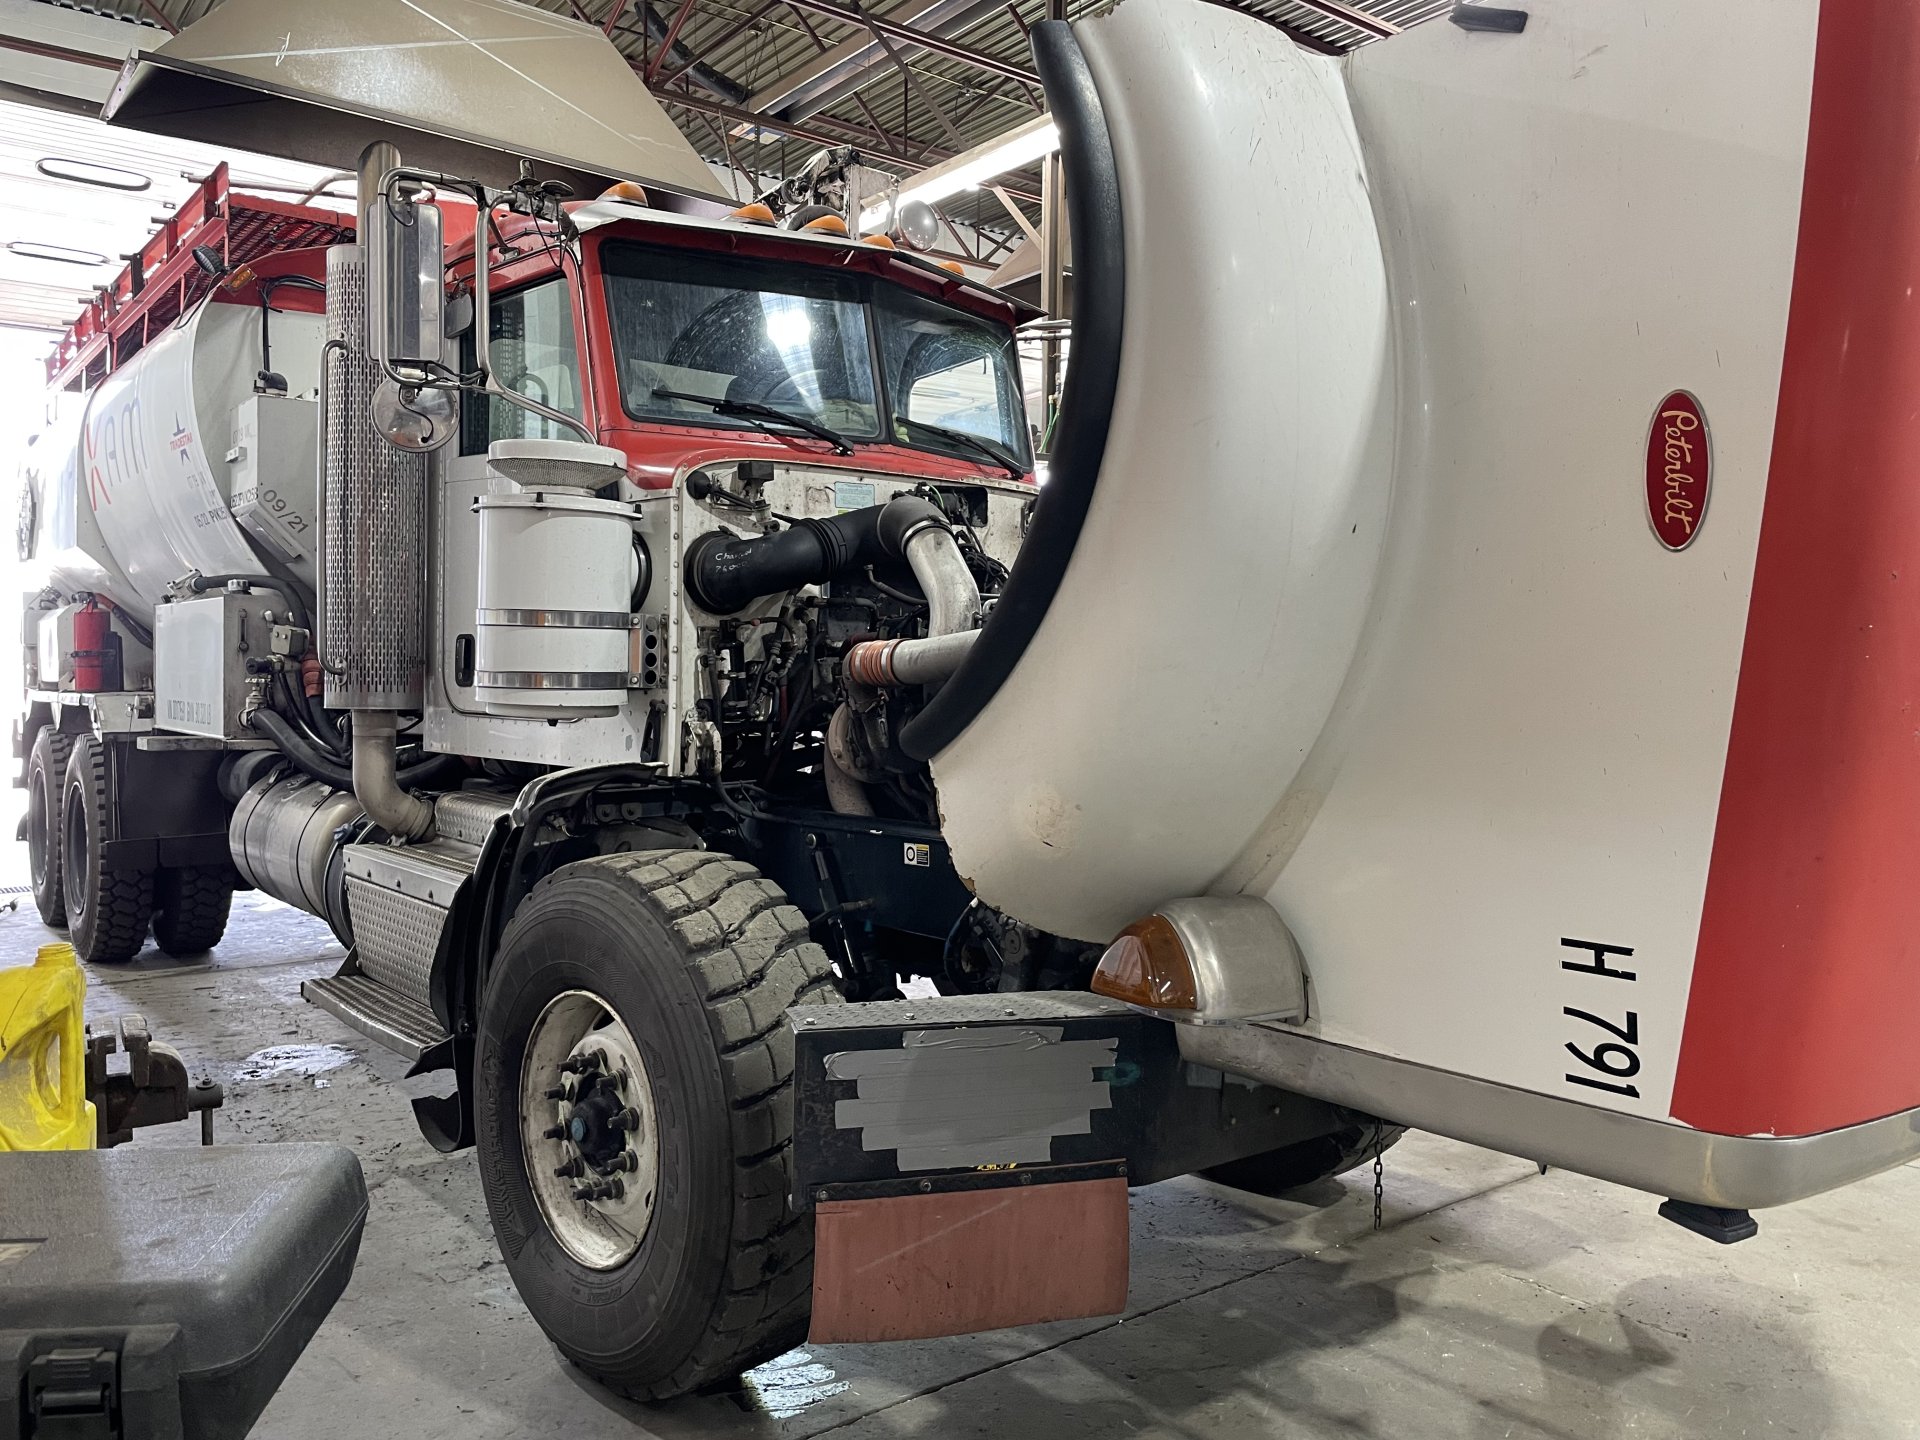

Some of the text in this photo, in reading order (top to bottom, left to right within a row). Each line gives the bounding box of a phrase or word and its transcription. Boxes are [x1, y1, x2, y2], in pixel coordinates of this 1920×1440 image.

[263, 489, 309, 534] 09/21
[1662, 410, 1699, 534] Peterbilt
[1559, 937, 1641, 1099] H 791
